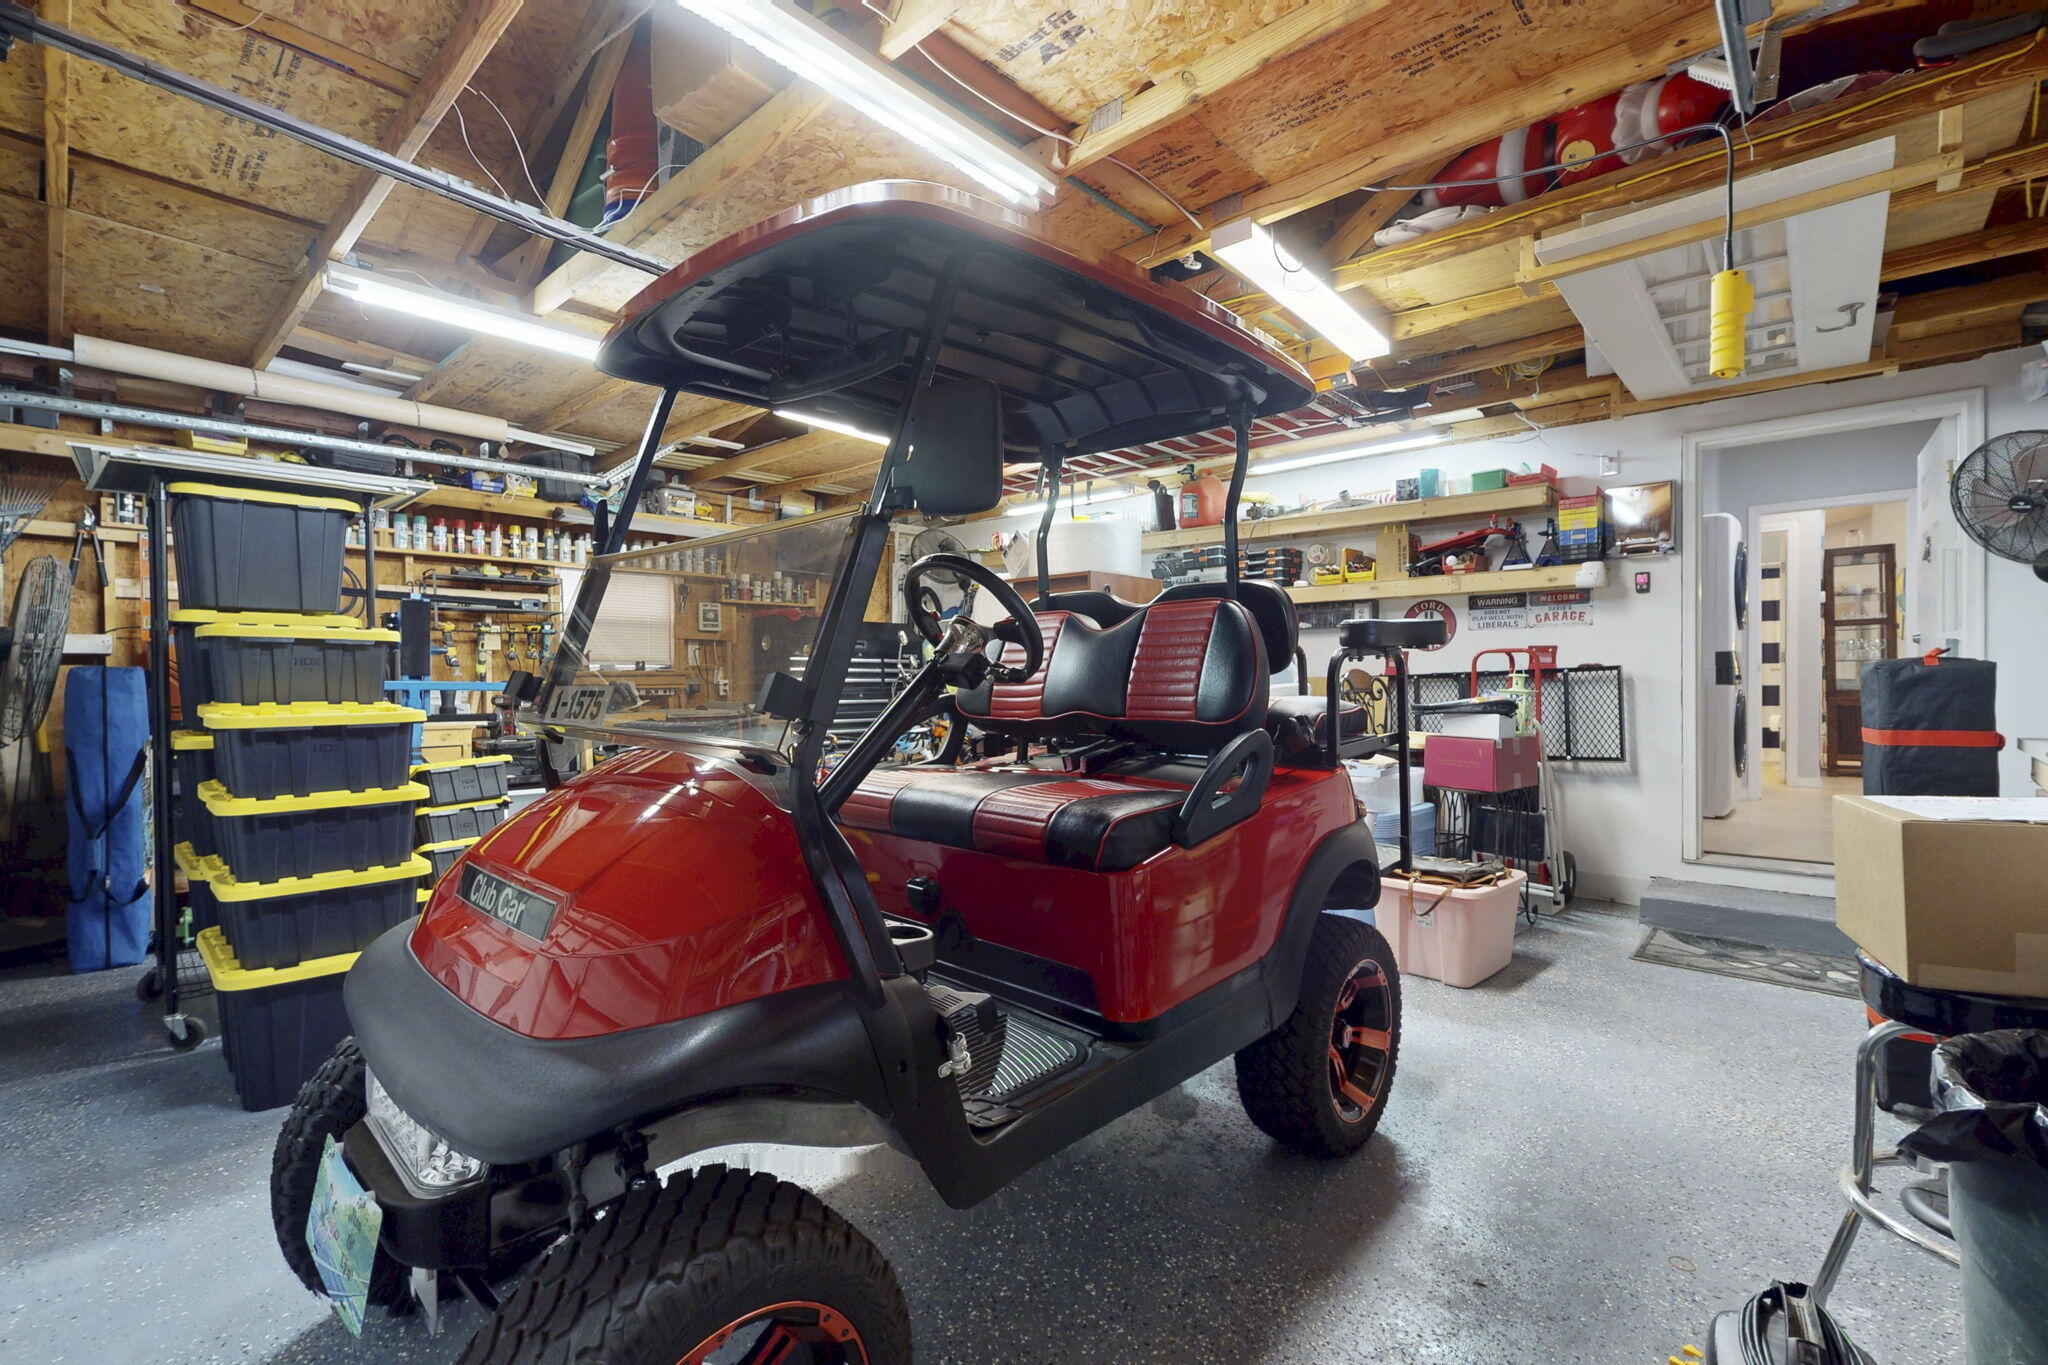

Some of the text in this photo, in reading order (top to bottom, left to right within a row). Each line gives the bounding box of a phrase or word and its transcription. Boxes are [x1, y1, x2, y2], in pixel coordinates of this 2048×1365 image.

[1477, 596, 1518, 606] WARNING
[1540, 592, 1581, 602] WELCOME
[1414, 601, 1445, 614] FORD
[1535, 611, 1586, 624] GARAGE
[1477, 621, 1519, 629] LIBERALS
[551, 690, 606, 720] 1-1575
[470, 874, 526, 924] Club Car
